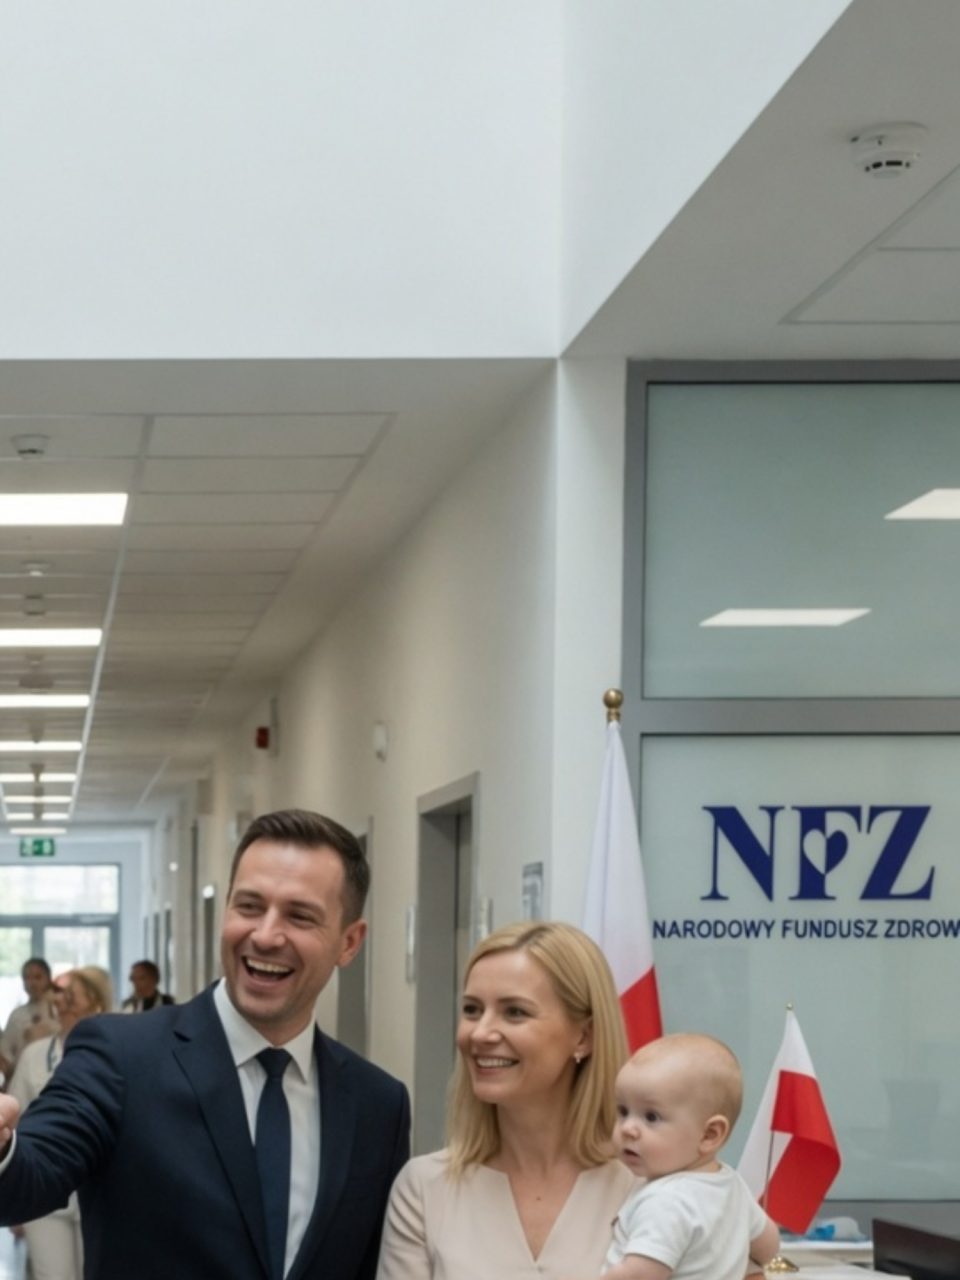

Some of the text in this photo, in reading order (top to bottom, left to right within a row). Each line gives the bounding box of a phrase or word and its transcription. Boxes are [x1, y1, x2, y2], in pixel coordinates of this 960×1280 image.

[700, 805, 936, 902] NFZ
[652, 919, 960, 939] NARODOWY FUNDUSZ ZDROW
